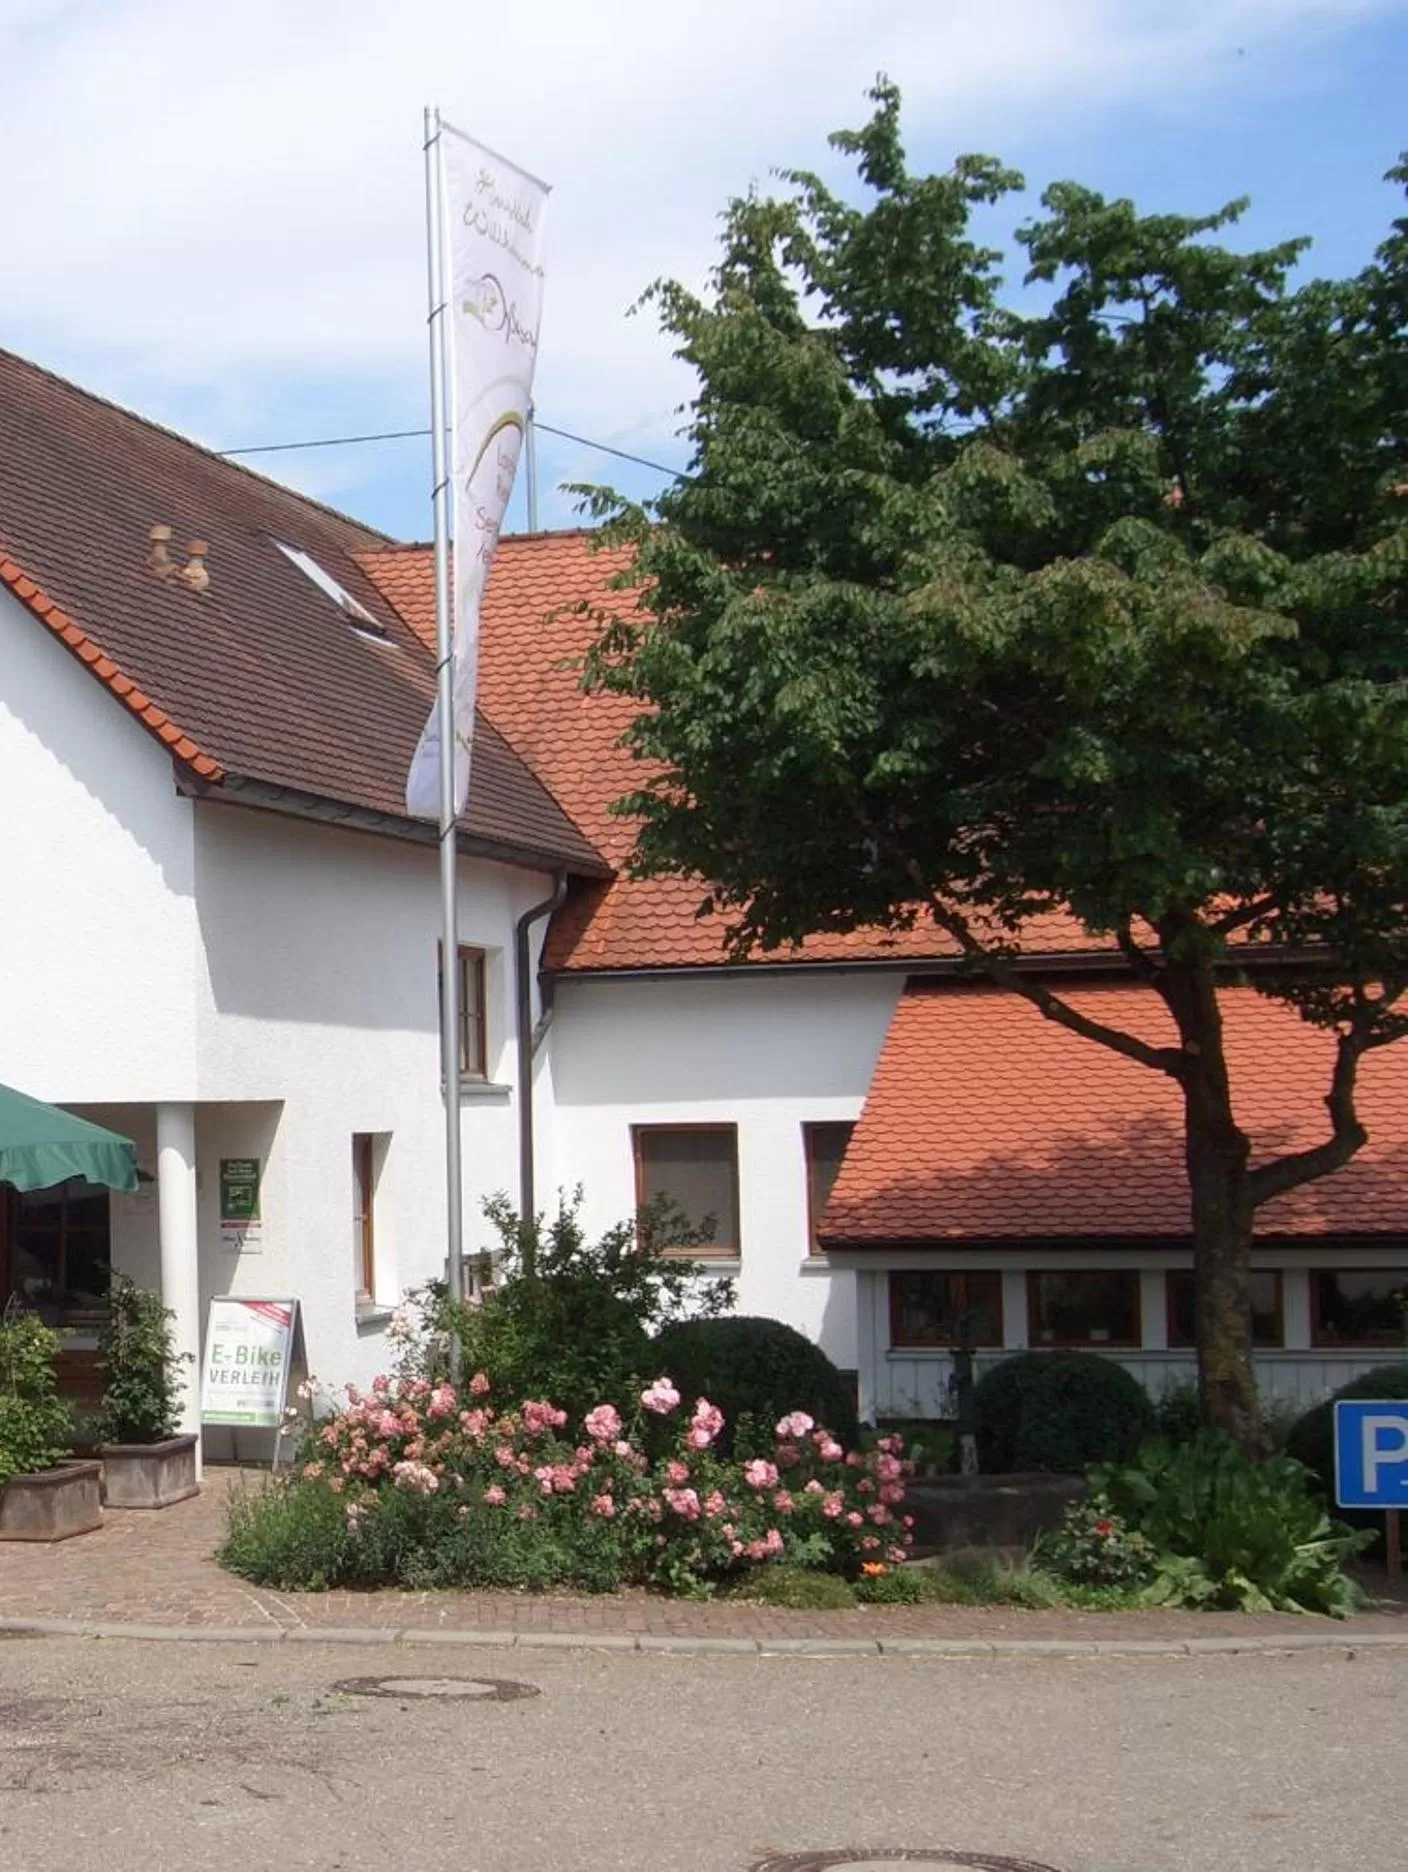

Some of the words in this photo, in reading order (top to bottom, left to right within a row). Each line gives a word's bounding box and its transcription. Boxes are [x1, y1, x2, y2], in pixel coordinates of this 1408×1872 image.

[211, 1343, 283, 1367] E-Bike
[209, 1367, 281, 1387] VERLEIH
[1361, 1415, 1408, 1494] P
